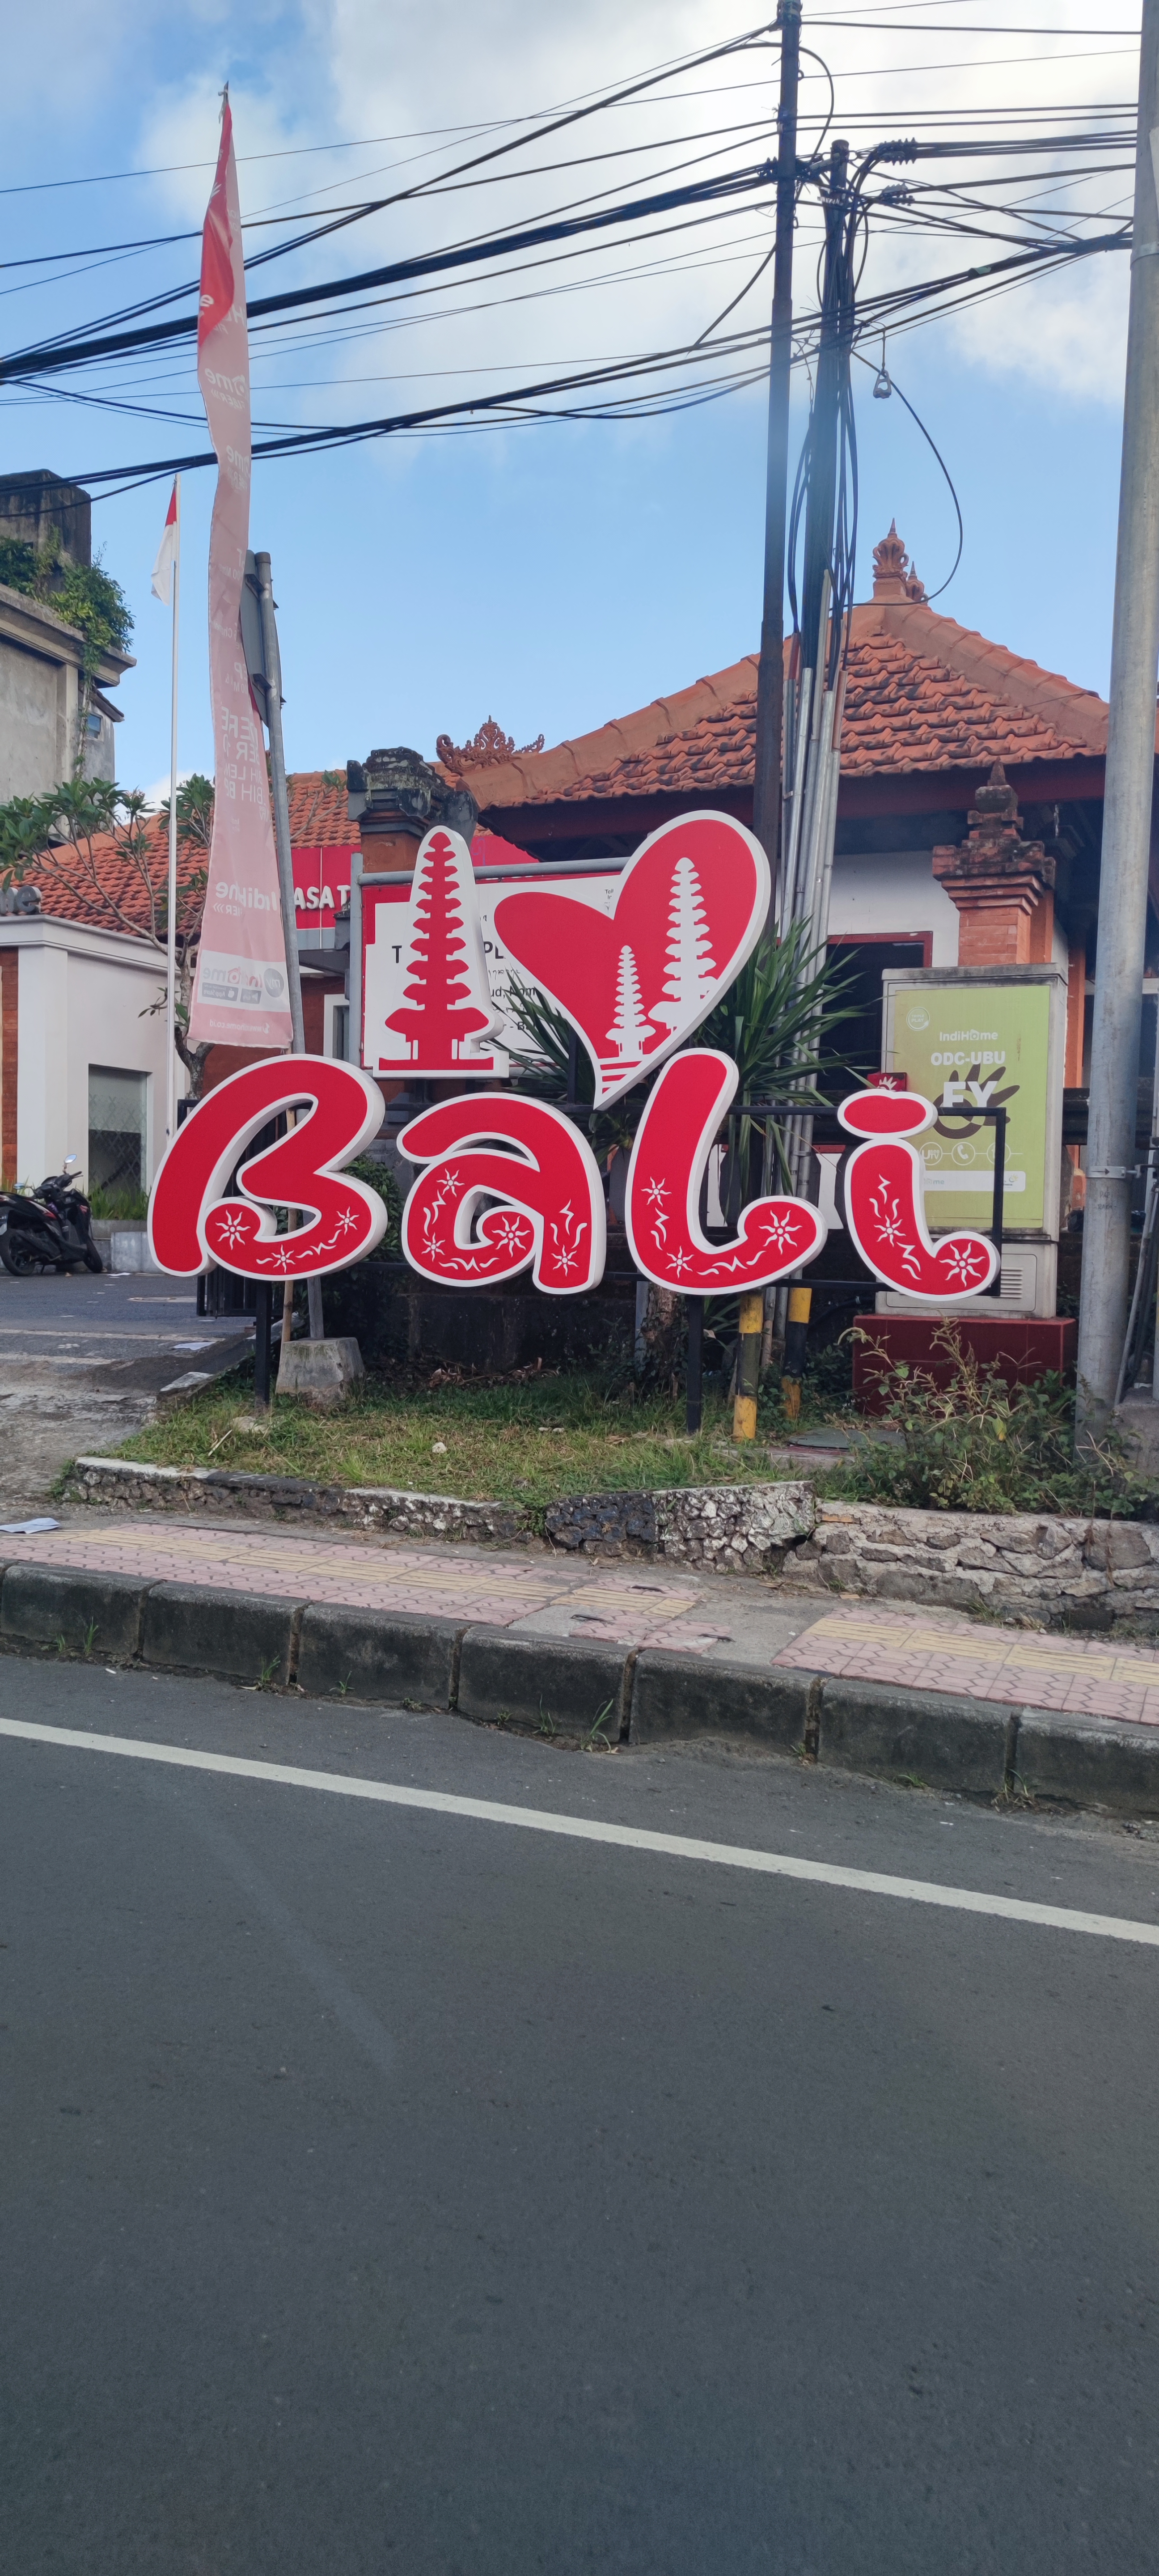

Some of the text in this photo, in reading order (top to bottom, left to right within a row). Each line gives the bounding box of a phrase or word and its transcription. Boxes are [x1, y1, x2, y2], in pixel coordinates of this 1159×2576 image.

[294, 886, 334, 910] ASA
[939, 1029, 998, 1041] IndiHome
[931, 1051, 1006, 1065] ODC-UBU
